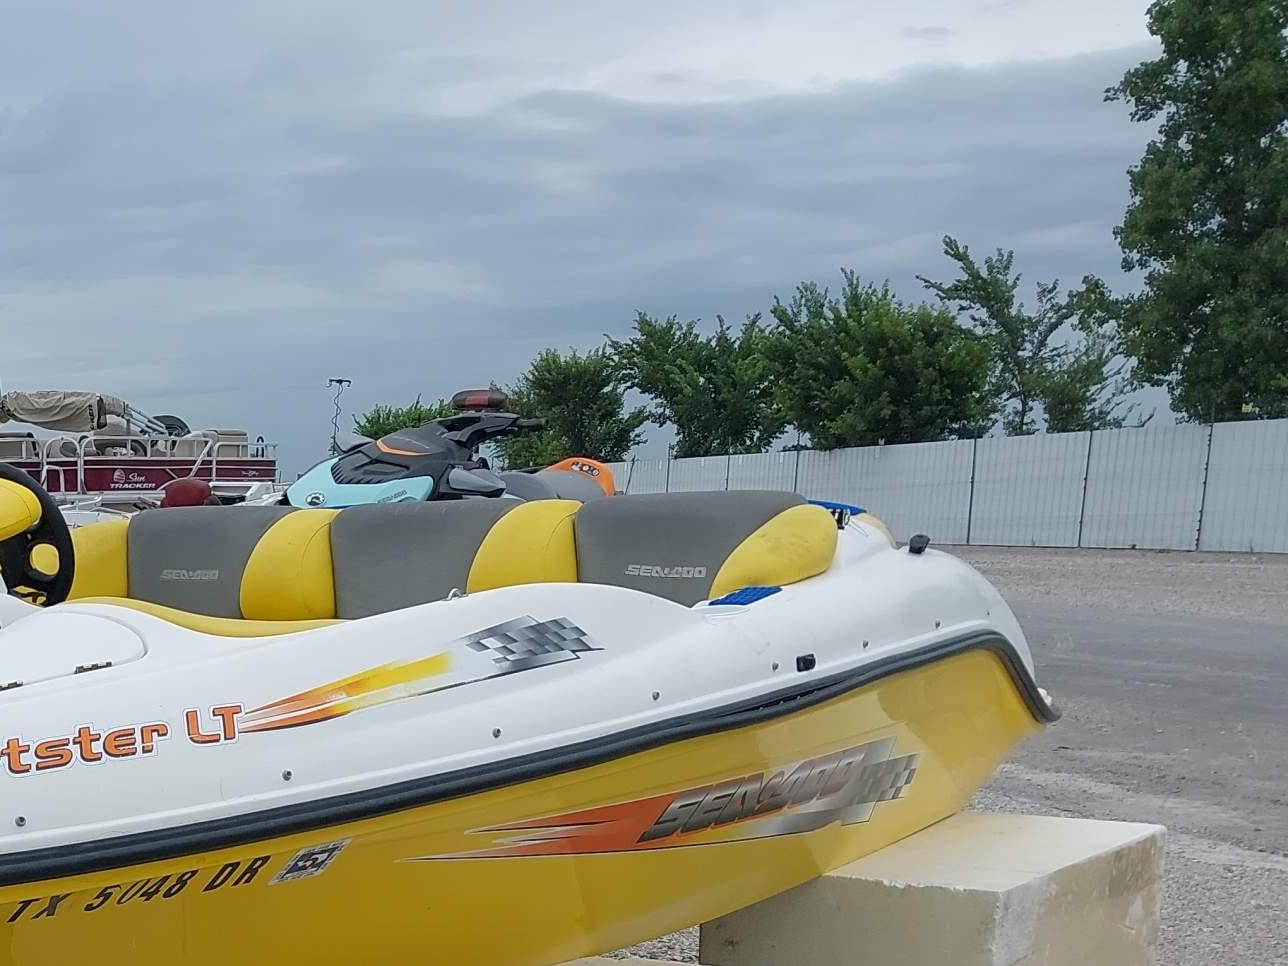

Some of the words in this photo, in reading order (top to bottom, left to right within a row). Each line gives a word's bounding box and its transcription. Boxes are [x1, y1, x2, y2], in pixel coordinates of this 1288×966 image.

[185, 704, 243, 743] LT
[7, 892, 72, 923] TX
[84, 869, 199, 912] 5048
[202, 855, 273, 893] DR
